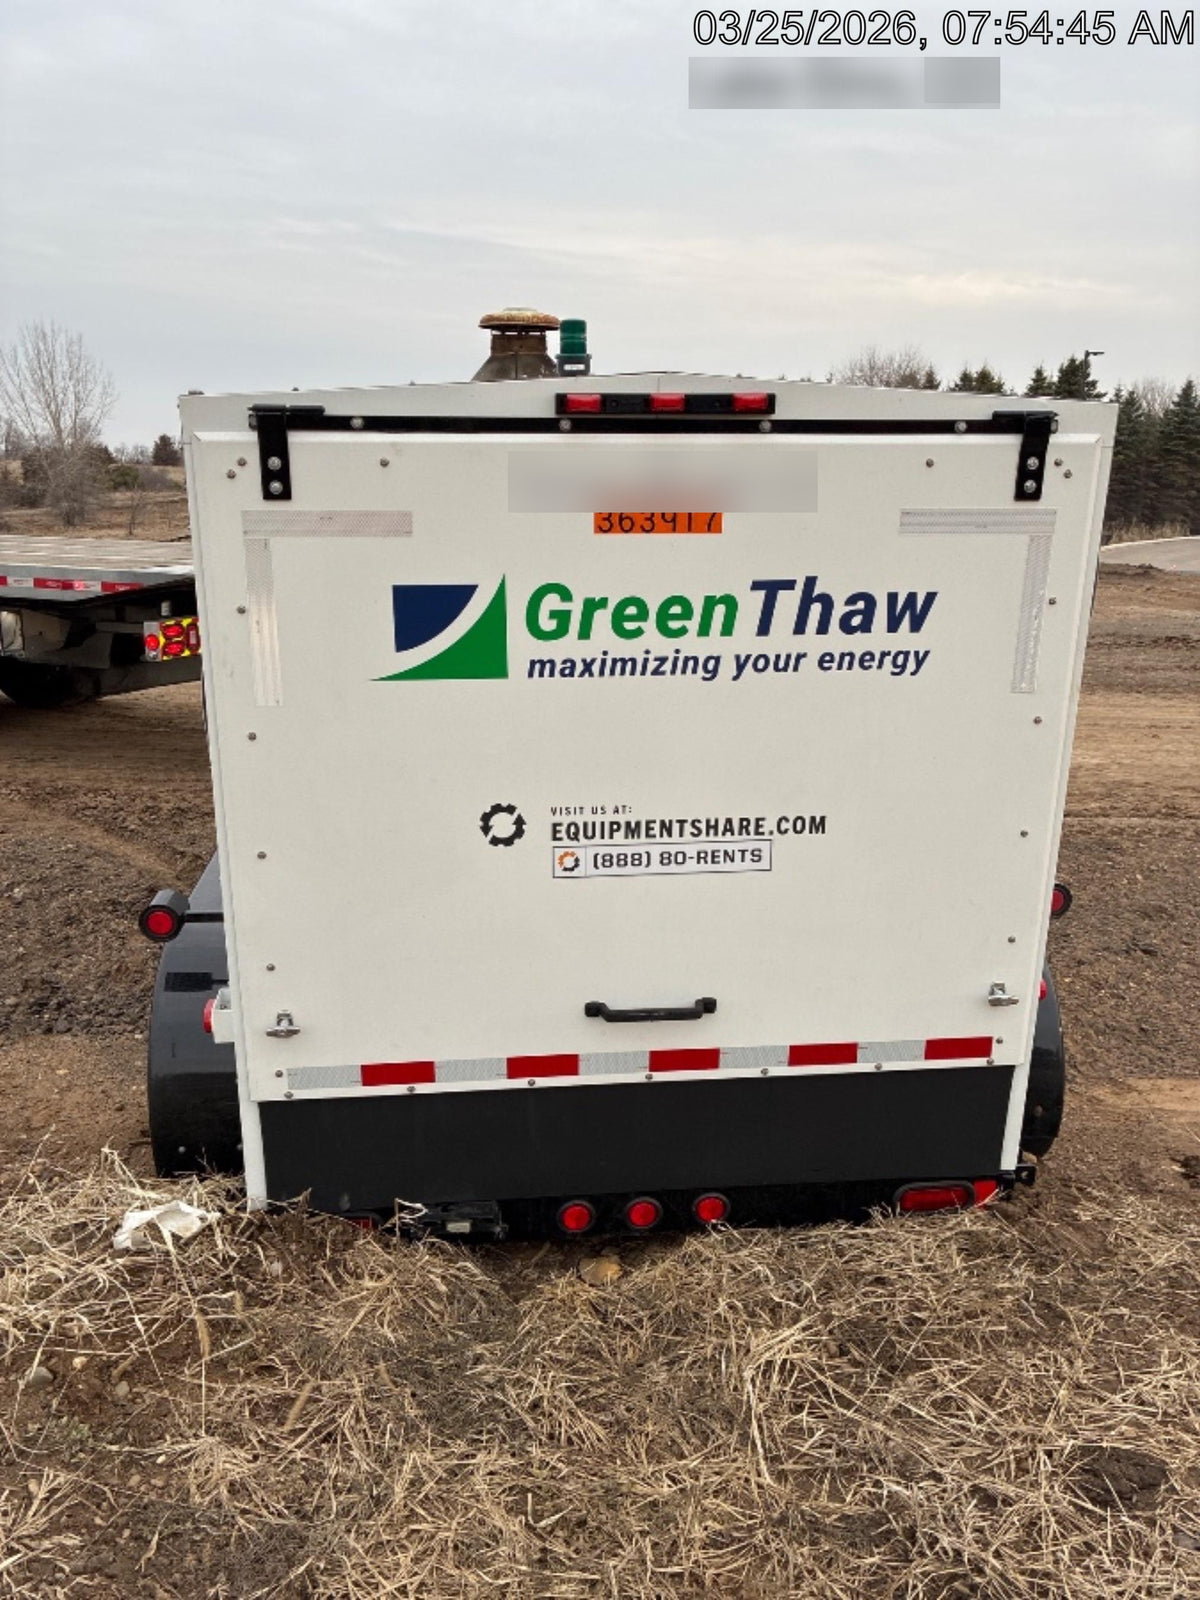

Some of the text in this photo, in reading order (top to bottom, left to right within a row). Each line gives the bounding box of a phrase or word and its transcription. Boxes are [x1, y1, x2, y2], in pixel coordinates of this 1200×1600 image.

[527, 649, 931, 682] maximizing your energy
[551, 805, 633, 817] VISIT US AT:
[551, 815, 827, 842] EQUIPMENTSHARE.COM
[593, 847, 763, 870] (888) 80-RENTS
